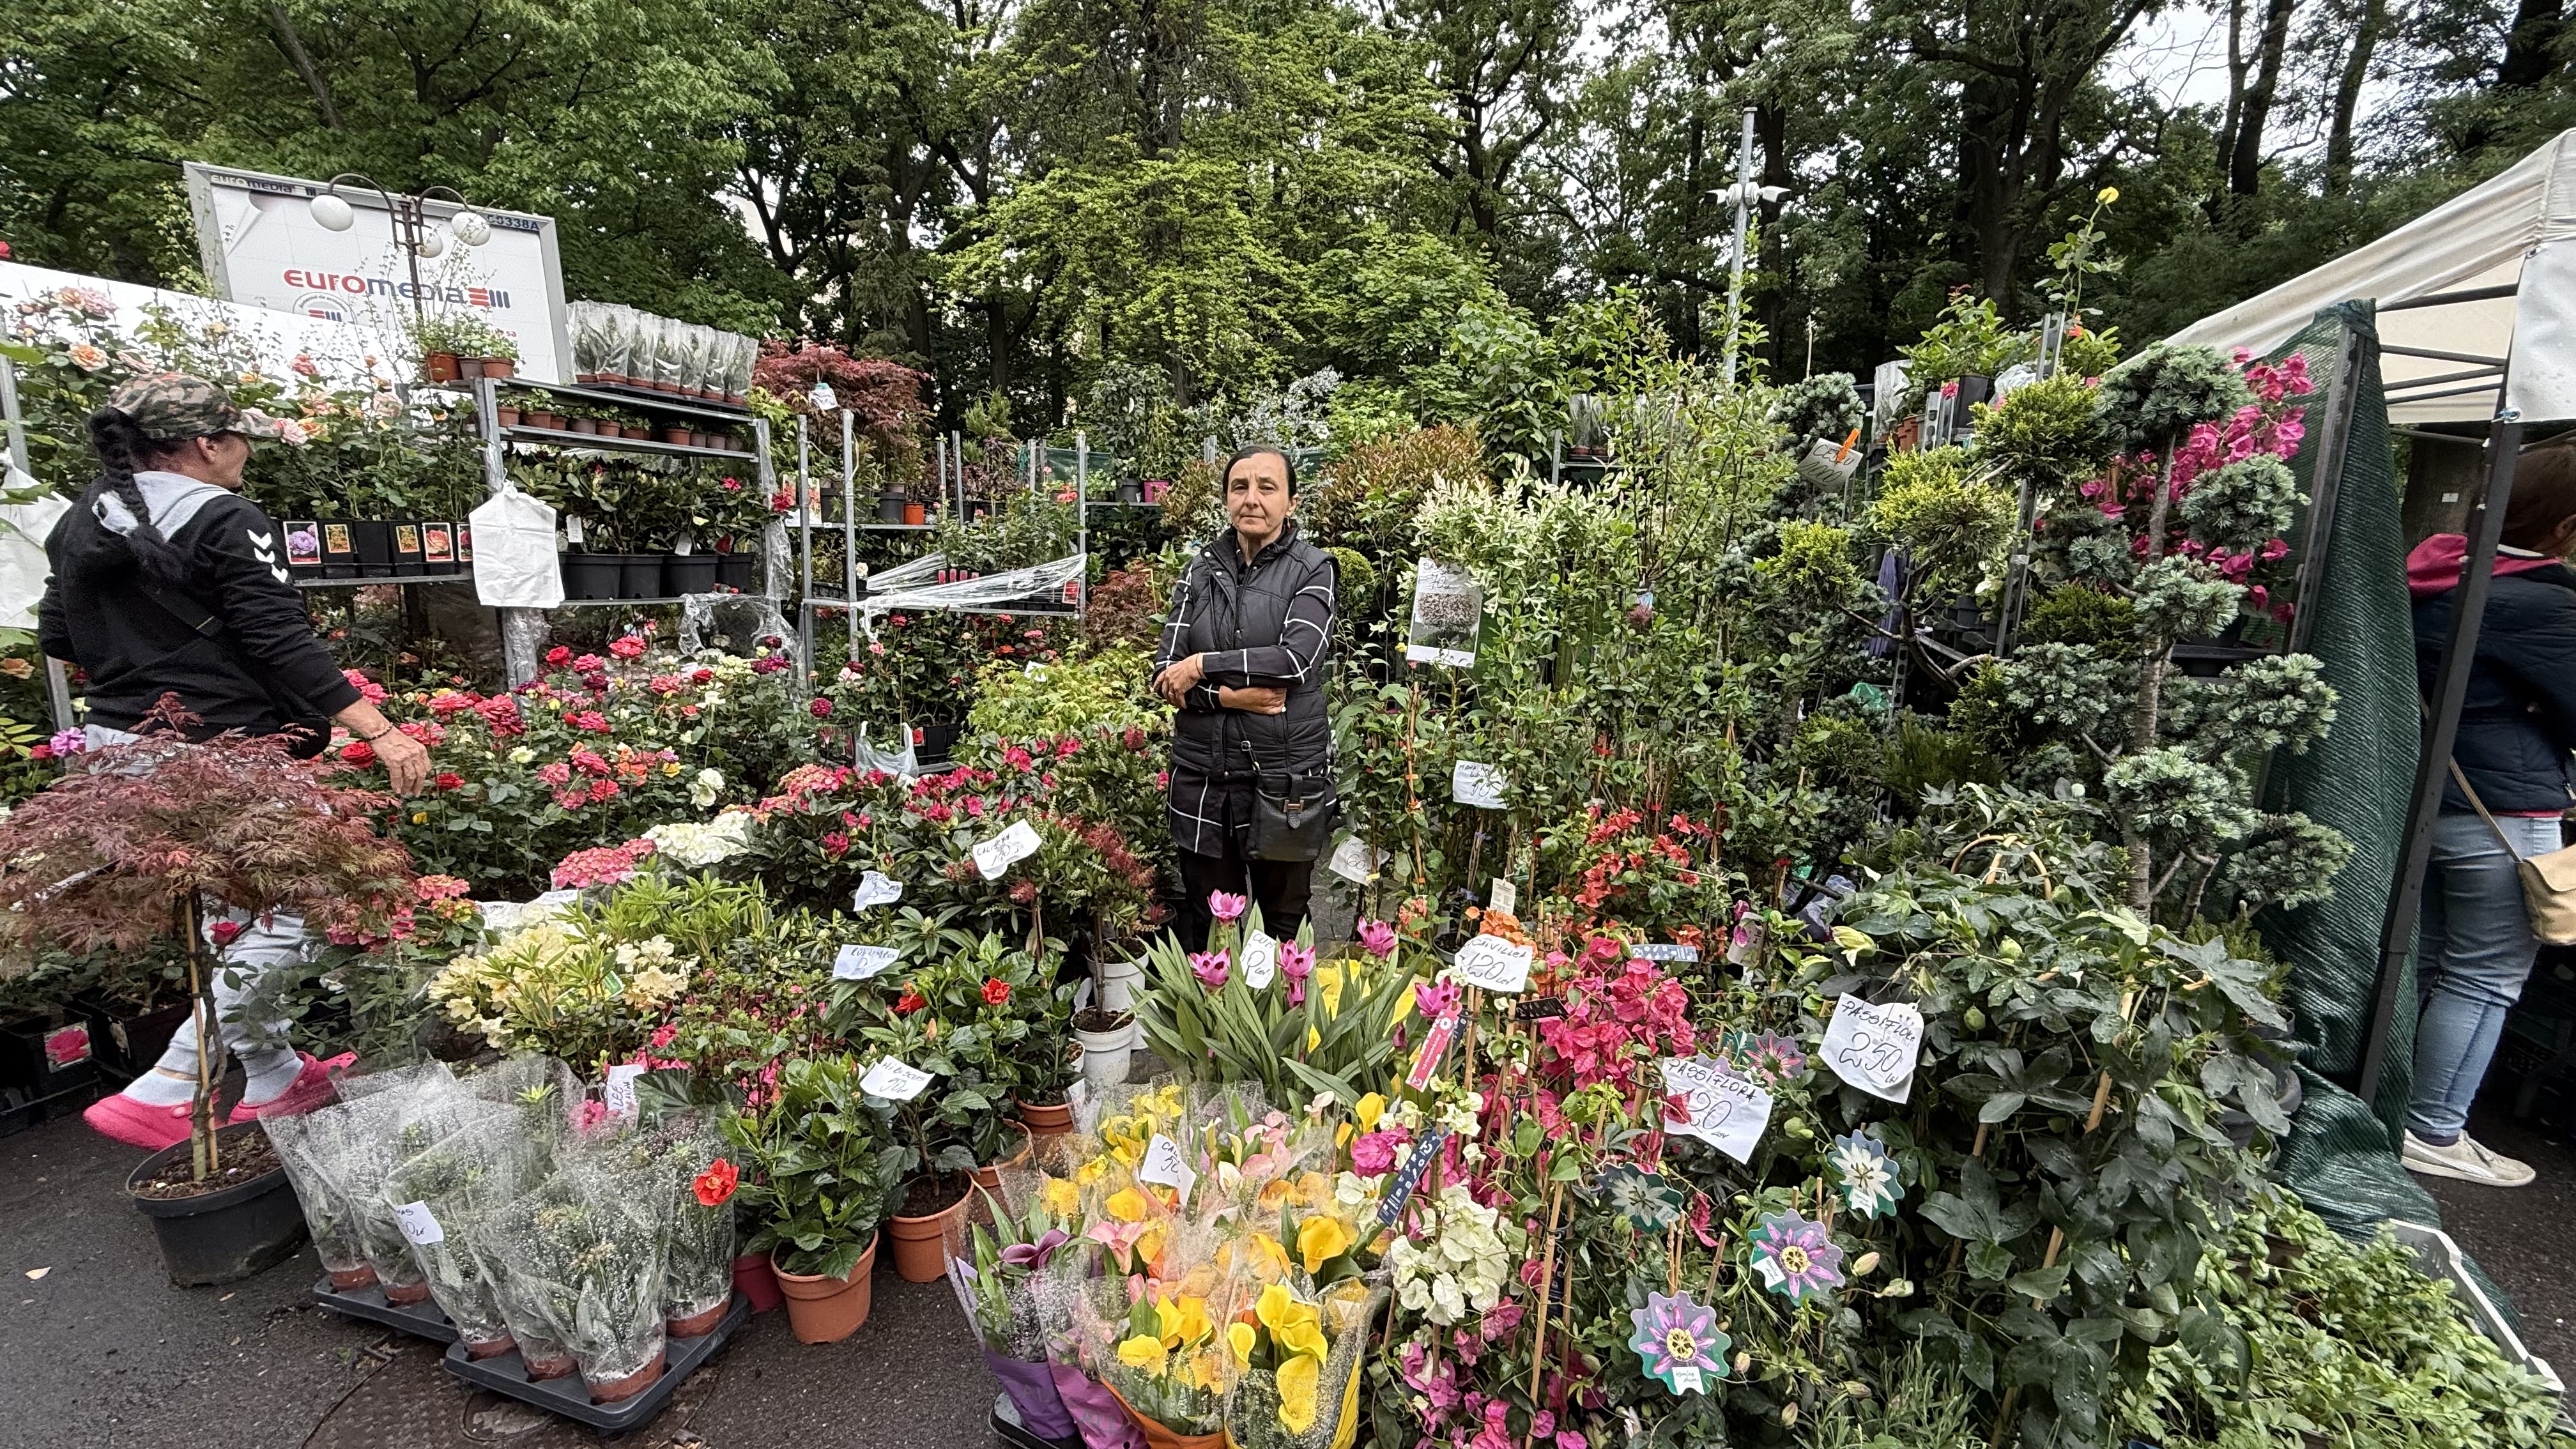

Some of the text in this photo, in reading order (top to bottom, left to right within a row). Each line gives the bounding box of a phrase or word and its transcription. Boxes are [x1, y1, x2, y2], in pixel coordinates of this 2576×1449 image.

[284, 269, 466, 304] euromedia
[1347, 854, 1366, 870] 60
[1467, 953, 1505, 980] 120
[1839, 1032, 1903, 1073] 250
[1668, 1058, 1757, 1103] PASSIFLORA
